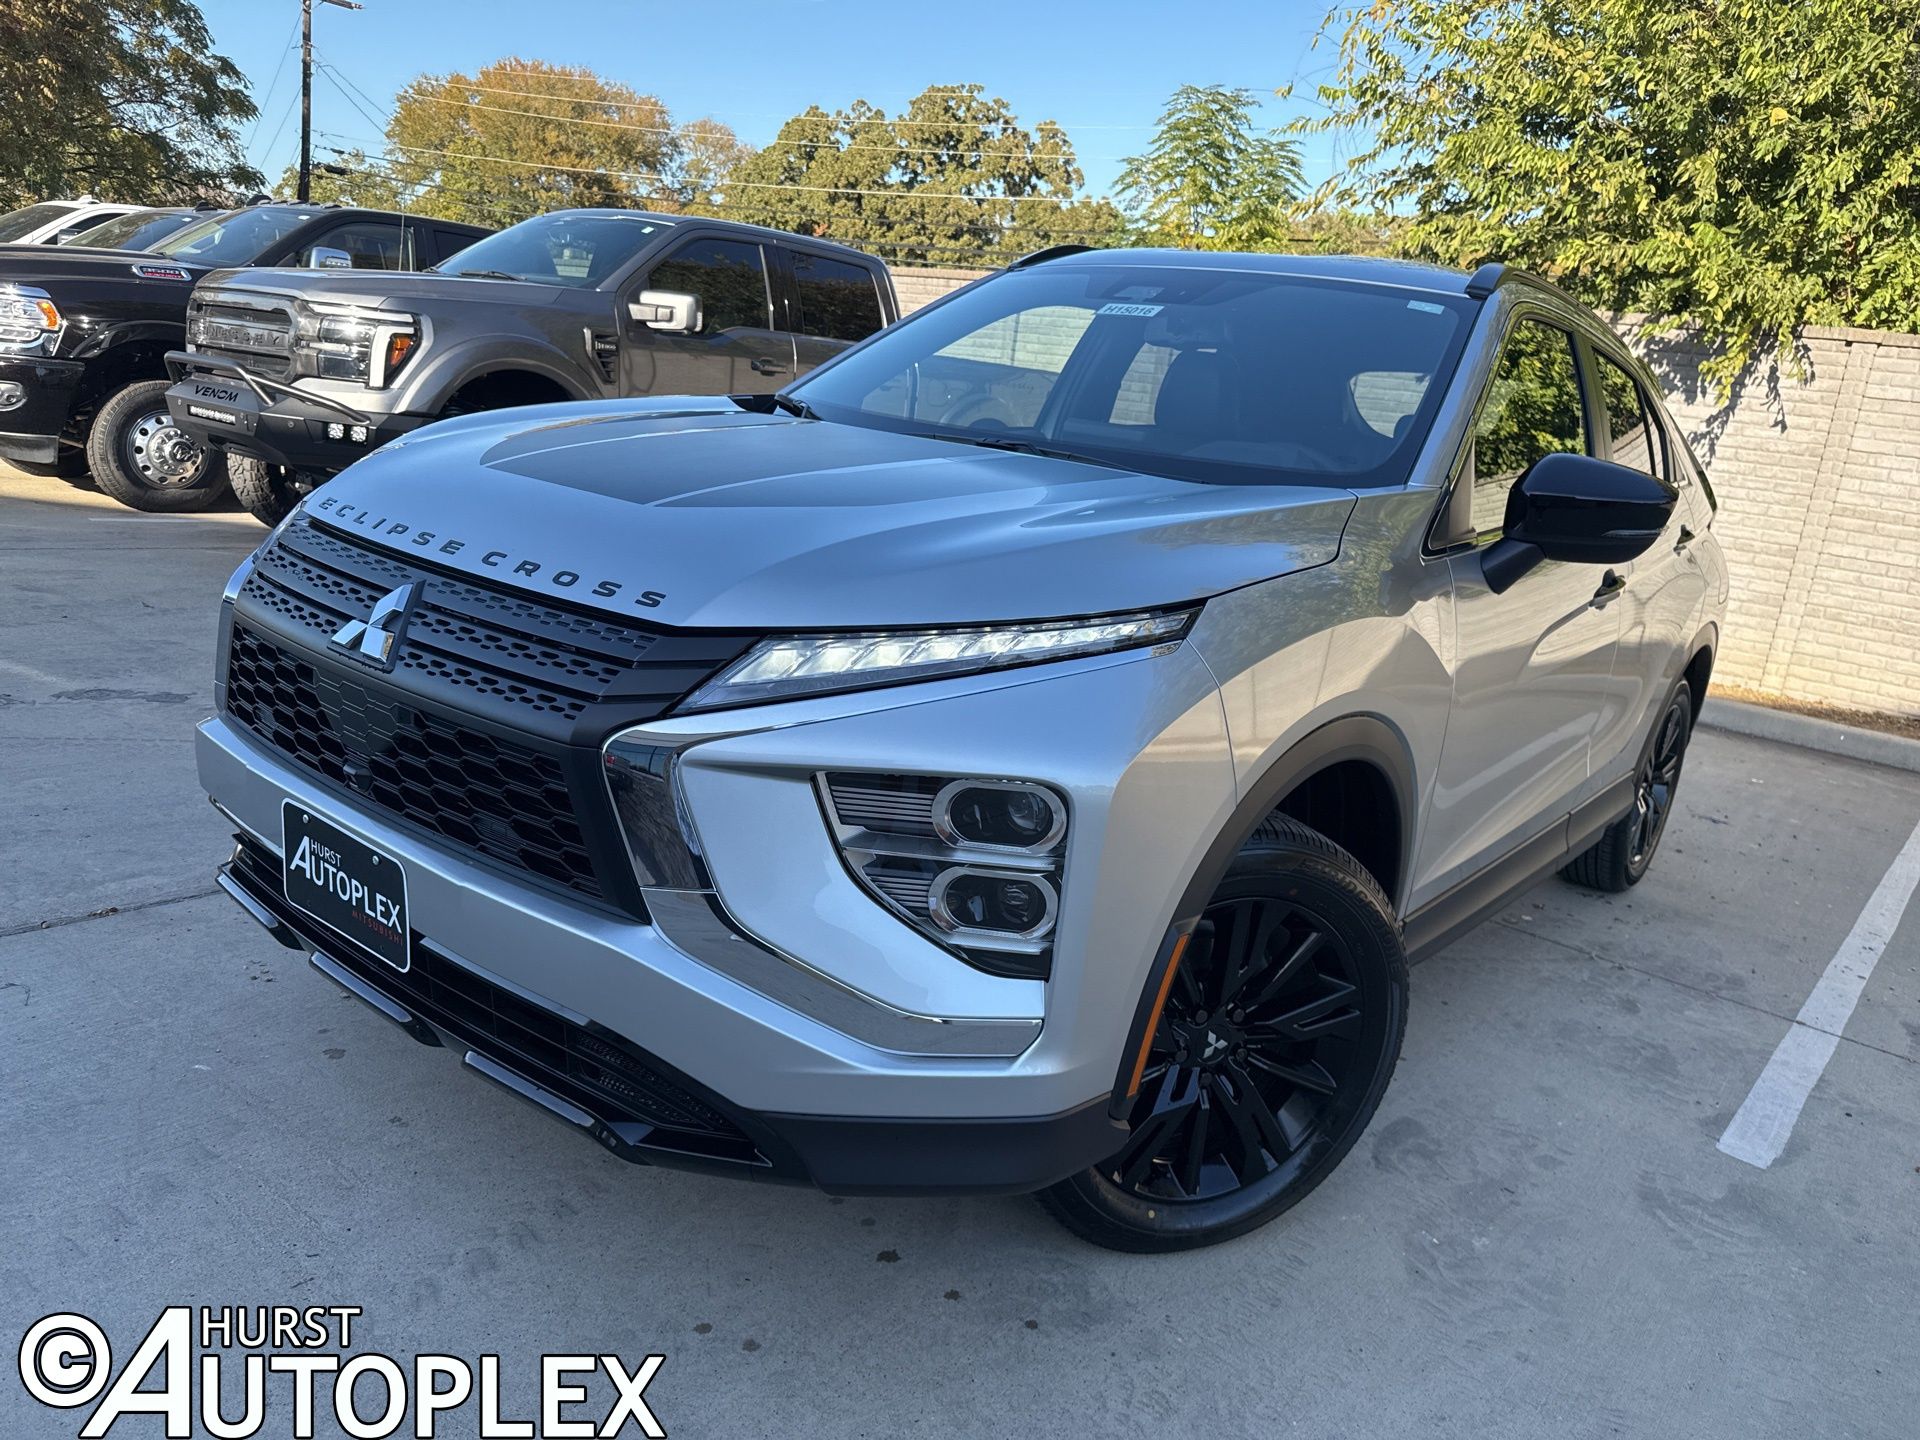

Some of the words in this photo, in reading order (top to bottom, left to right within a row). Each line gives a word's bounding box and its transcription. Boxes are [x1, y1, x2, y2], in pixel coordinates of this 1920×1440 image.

[195, 384, 239, 402] VENOM
[318, 497, 466, 555] ECLIPSE
[481, 551, 667, 608] CROSS
[311, 839, 341, 867] HURST
[289, 835, 403, 934] AUTOPLEX
[352, 910, 403, 947] MITSUBISHI
